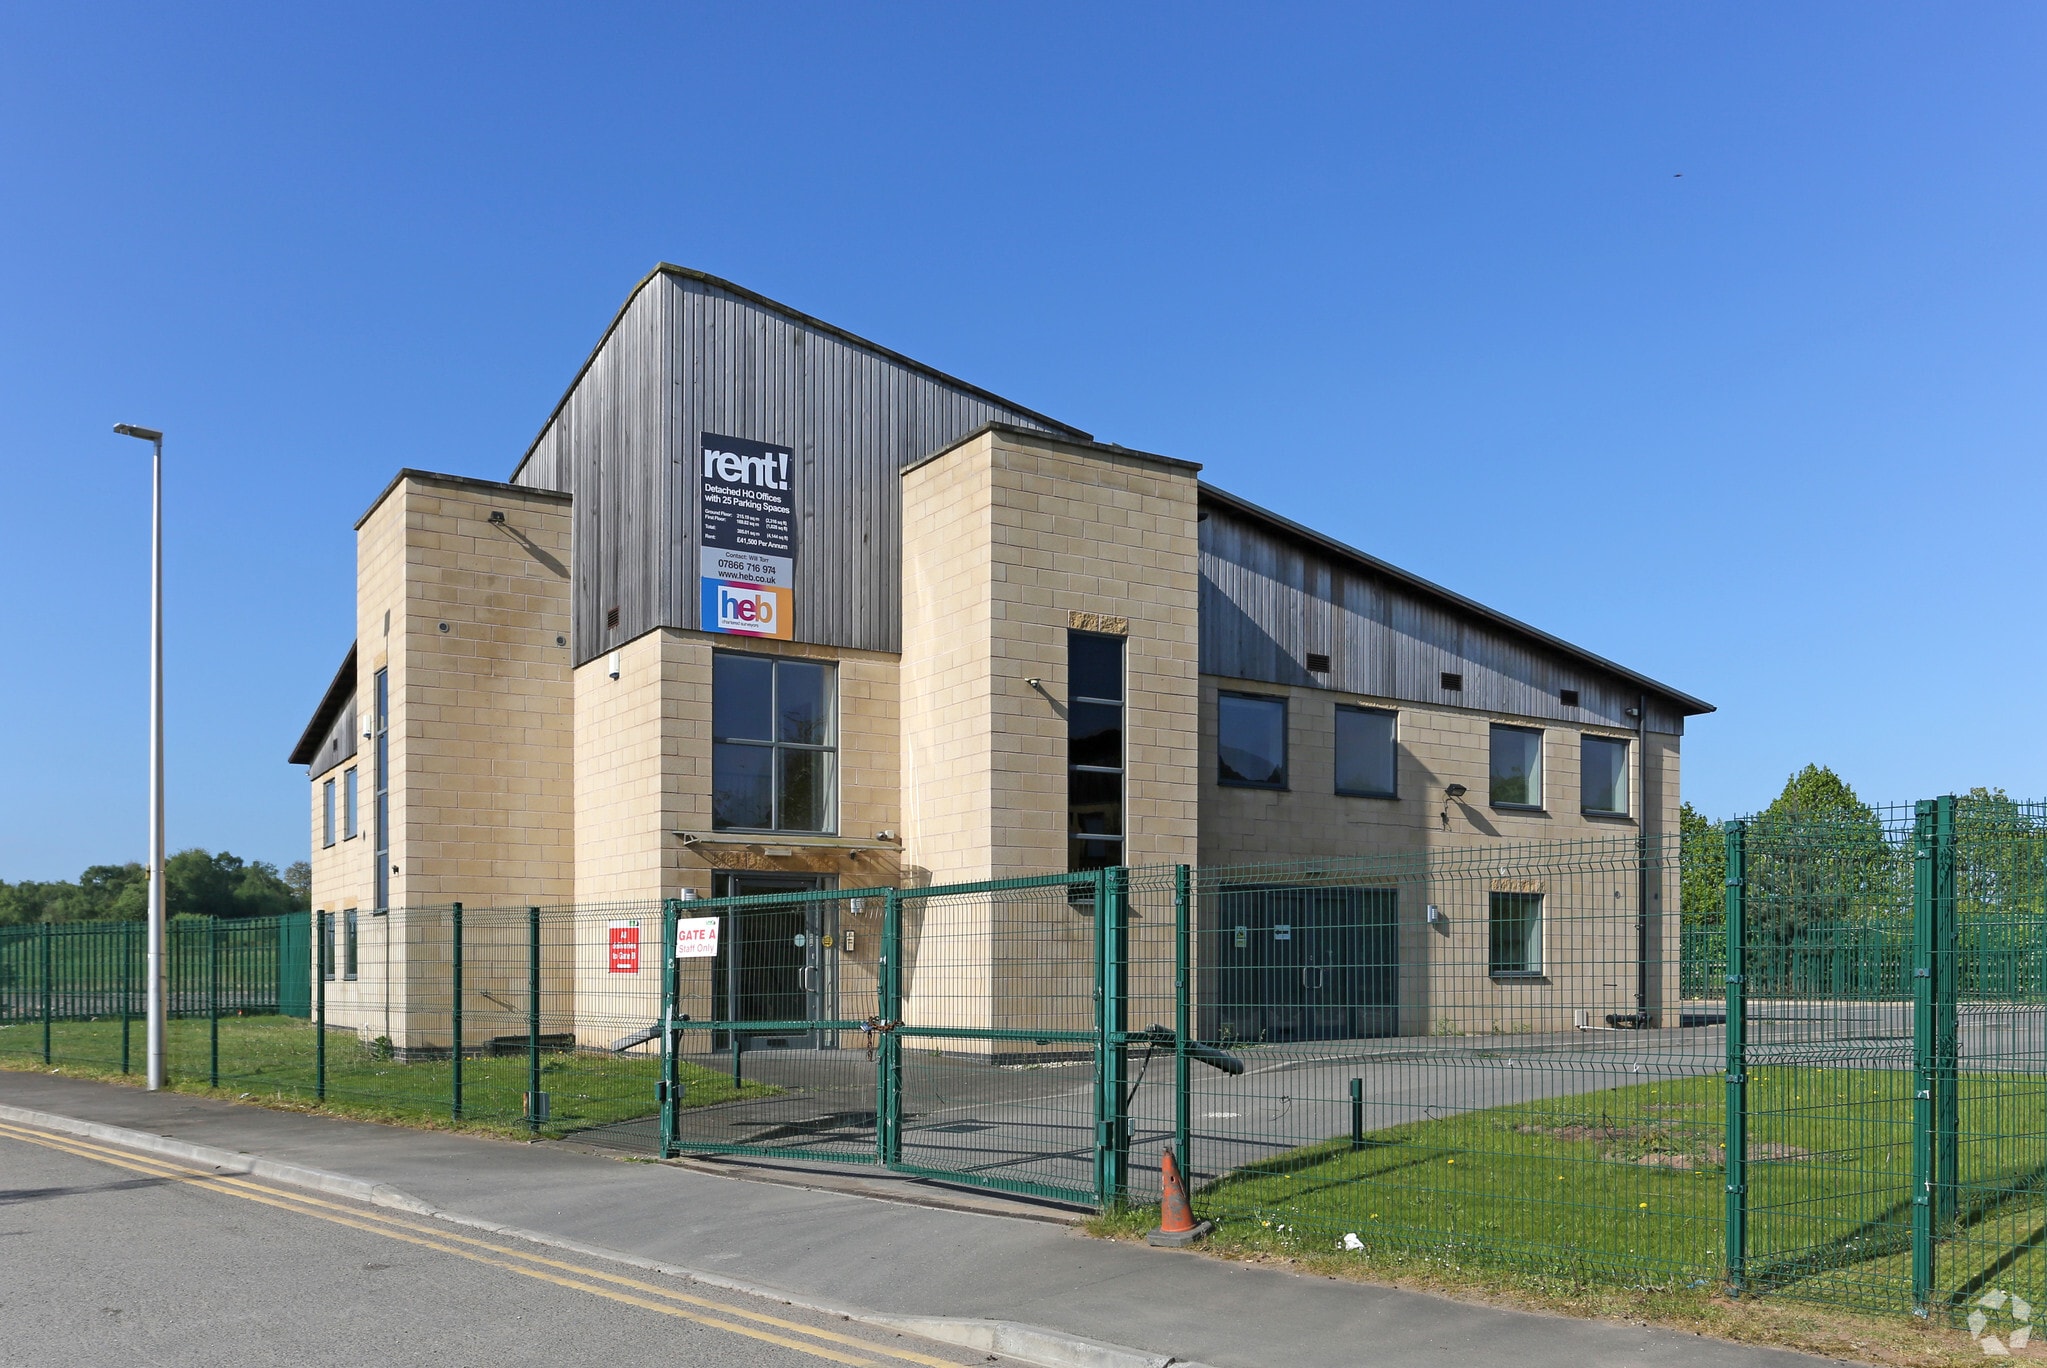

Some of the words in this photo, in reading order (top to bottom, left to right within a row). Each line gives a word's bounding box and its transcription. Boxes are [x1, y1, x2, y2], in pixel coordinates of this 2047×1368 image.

[704, 448, 788, 490] rent!
[705, 484, 740, 496] Detached
[742, 490, 755, 499] HQ
[756, 492, 782, 503] Offices
[705, 494, 721, 503] with
[722, 496, 732, 504] 25
[734, 498, 761, 511] Parking
[763, 502, 790, 514] Spaces
[736, 537, 758, 545] £41,500
[768, 541, 788, 550] Annum
[726, 552, 747, 560] Contact:
[718, 559, 744, 570] 07866
[747, 563, 760, 572] 716
[763, 565, 776, 574] 974
[718, 571, 776, 584] www.heb.co.uk
[722, 590, 773, 623] heb
[679, 929, 705, 941] GATE
[709, 929, 716, 939] A
[679, 944, 695, 953] Staff
[697, 944, 714, 954] Only
